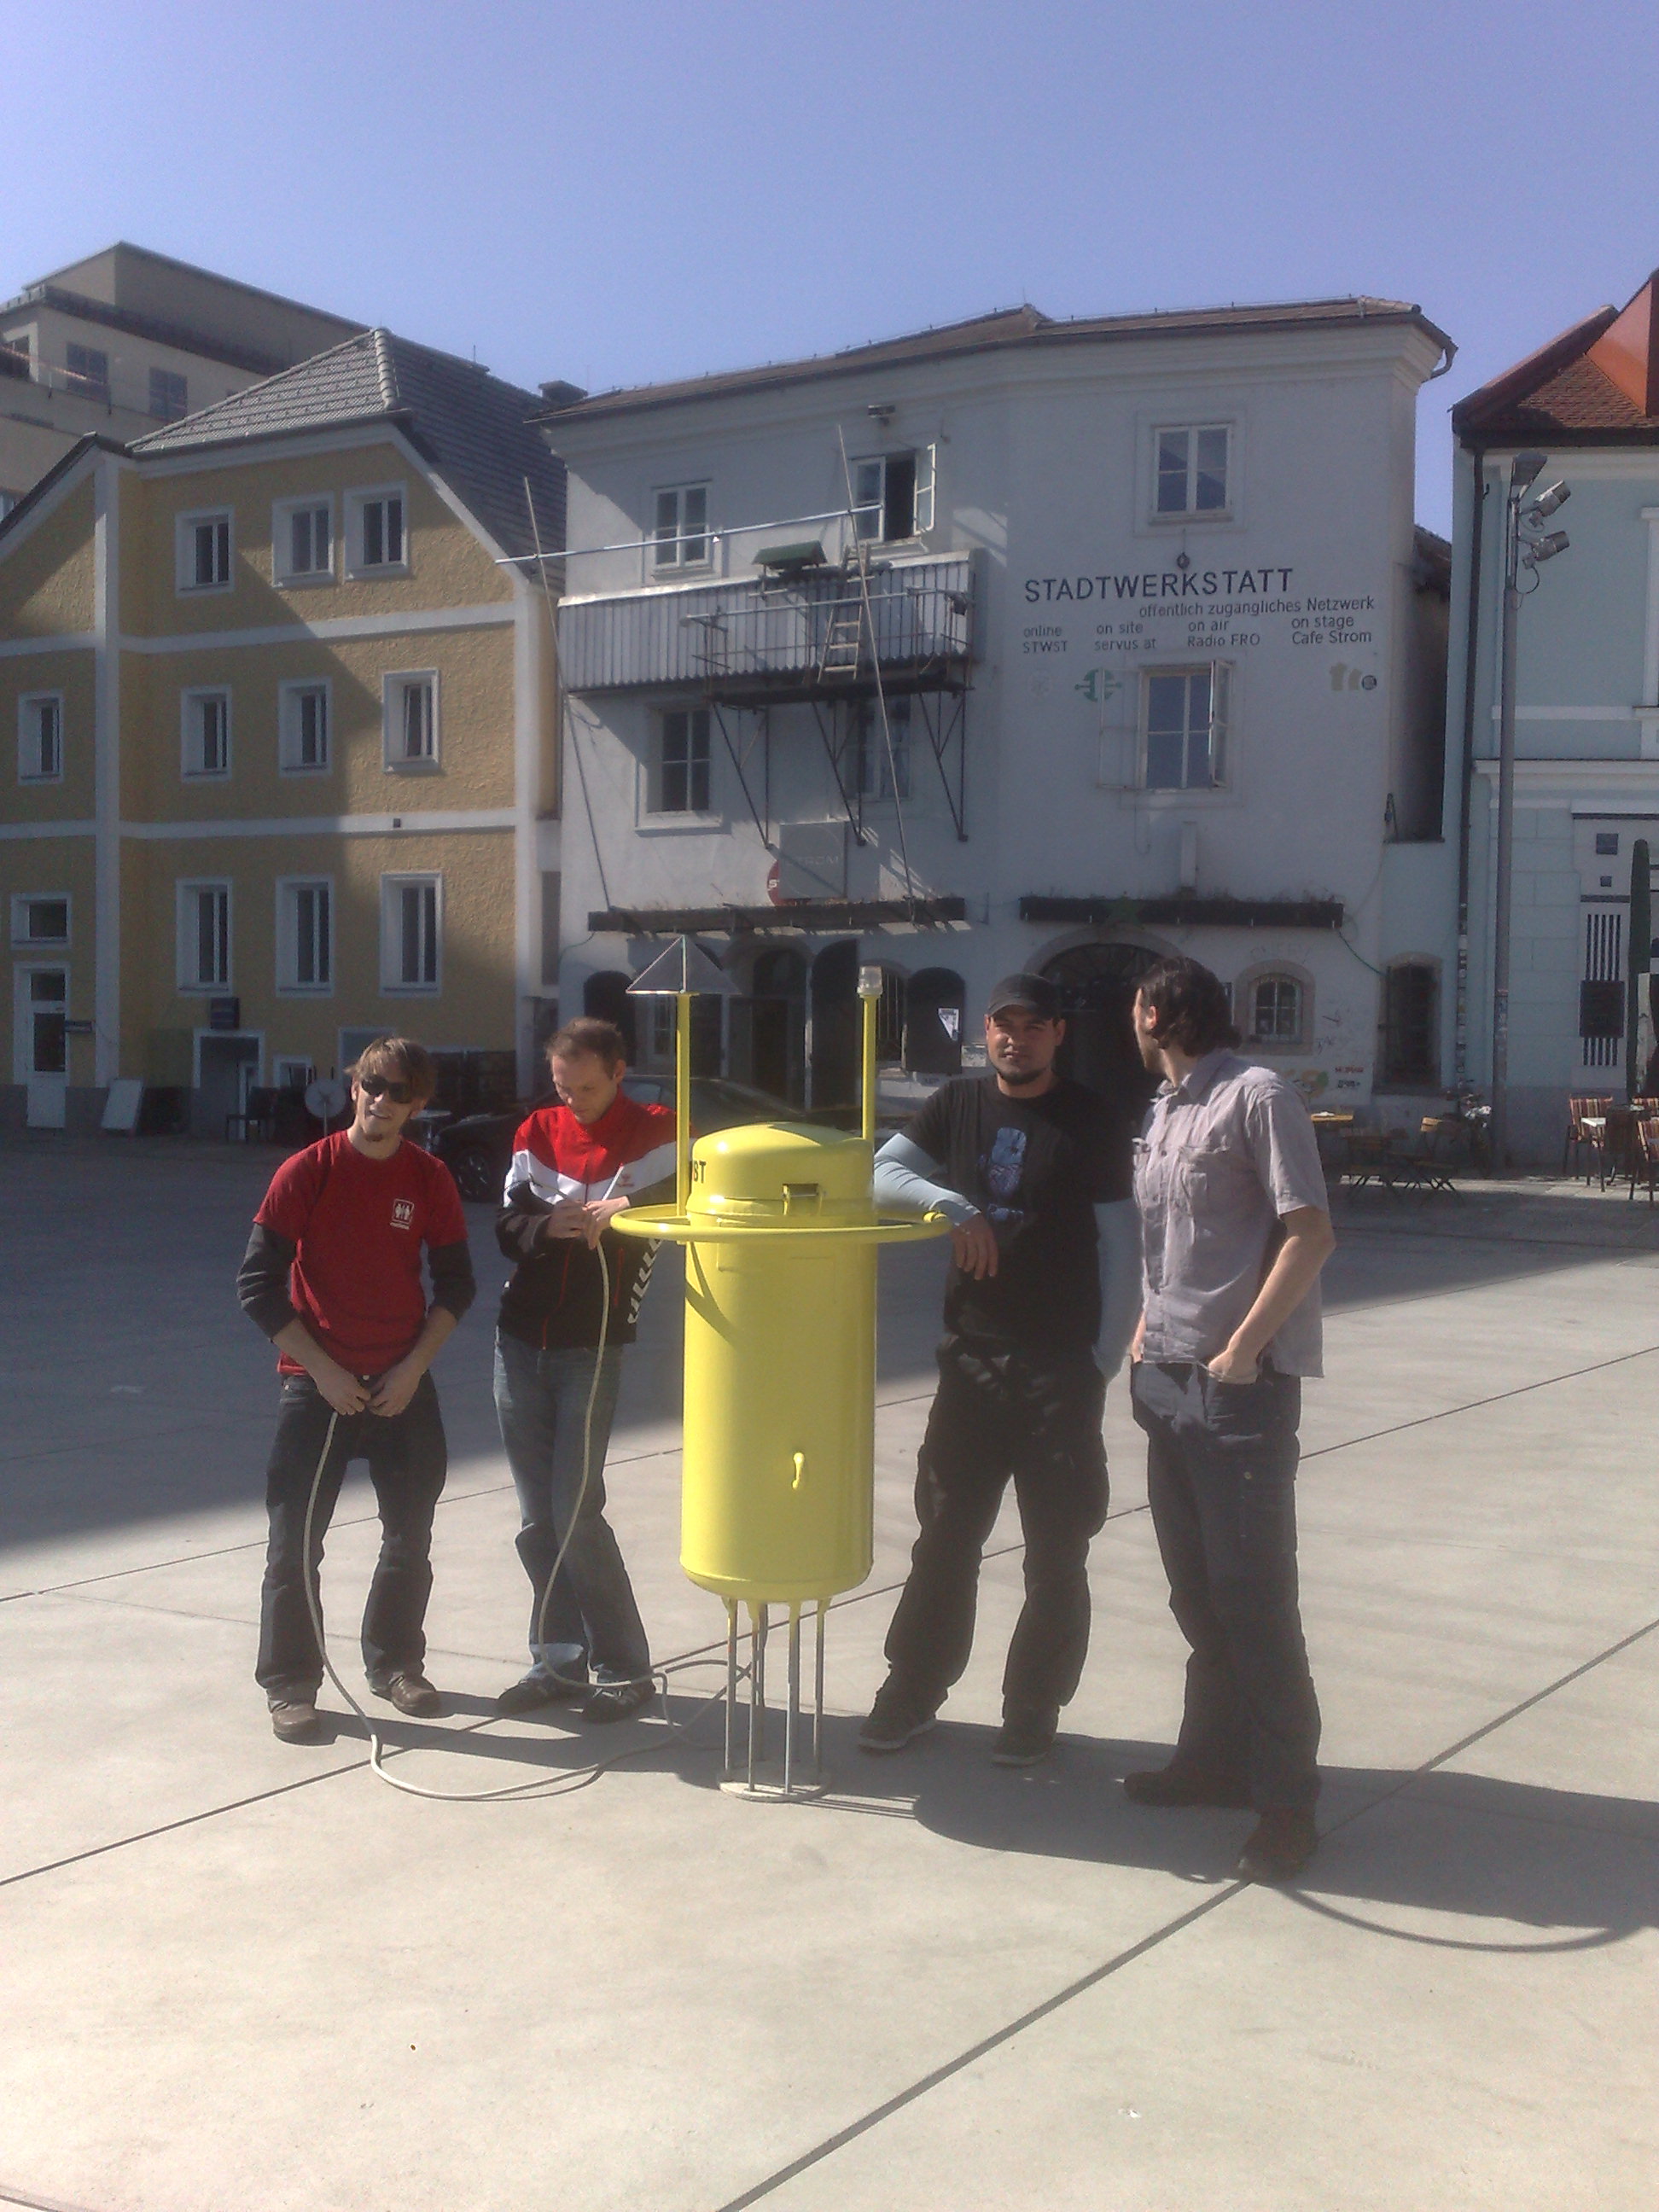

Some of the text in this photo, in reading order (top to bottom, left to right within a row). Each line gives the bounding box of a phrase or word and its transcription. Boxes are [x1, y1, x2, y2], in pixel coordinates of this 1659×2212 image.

[1025, 568, 1294, 603] STADTWERKSTATT
[1307, 596, 1375, 612] Netzwerk
[1097, 620, 1144, 635] on site
[1188, 620, 1229, 632] on air
[1291, 615, 1354, 630] on stage
[1023, 625, 1062, 638] online
[1292, 630, 1372, 644] Cafe Strom
[1022, 640, 1068, 654] STWST
[1187, 633, 1260, 647] Radio FRO
